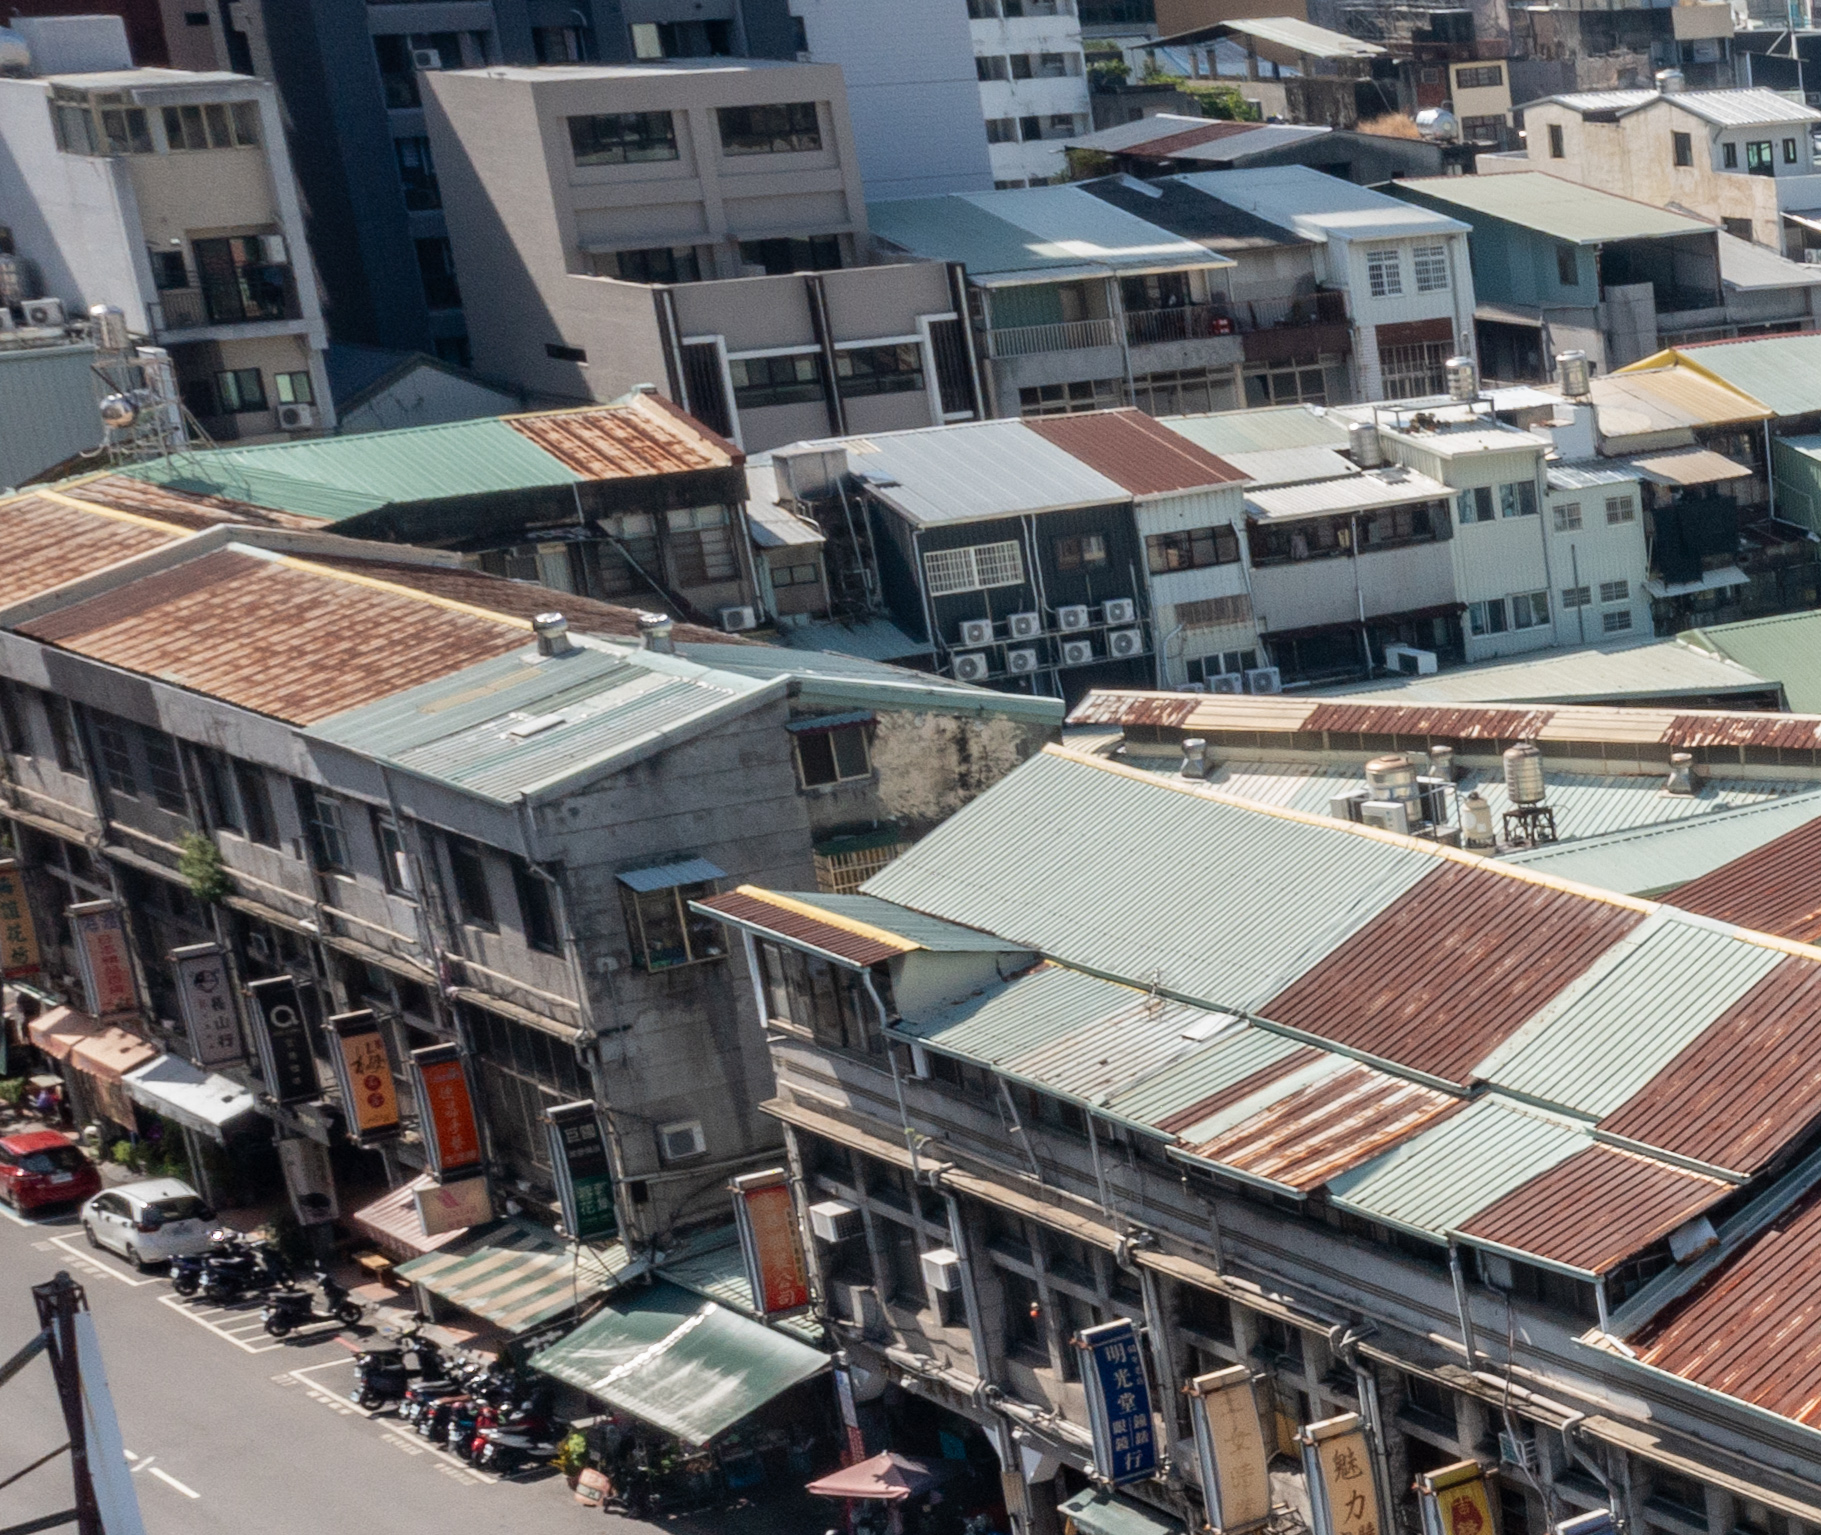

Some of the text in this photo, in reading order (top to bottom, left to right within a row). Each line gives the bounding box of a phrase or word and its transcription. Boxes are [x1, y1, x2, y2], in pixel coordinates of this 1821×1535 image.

[1104, 1341, 1138, 1415] 明光堂
[1331, 1446, 1366, 1525] 魅力
